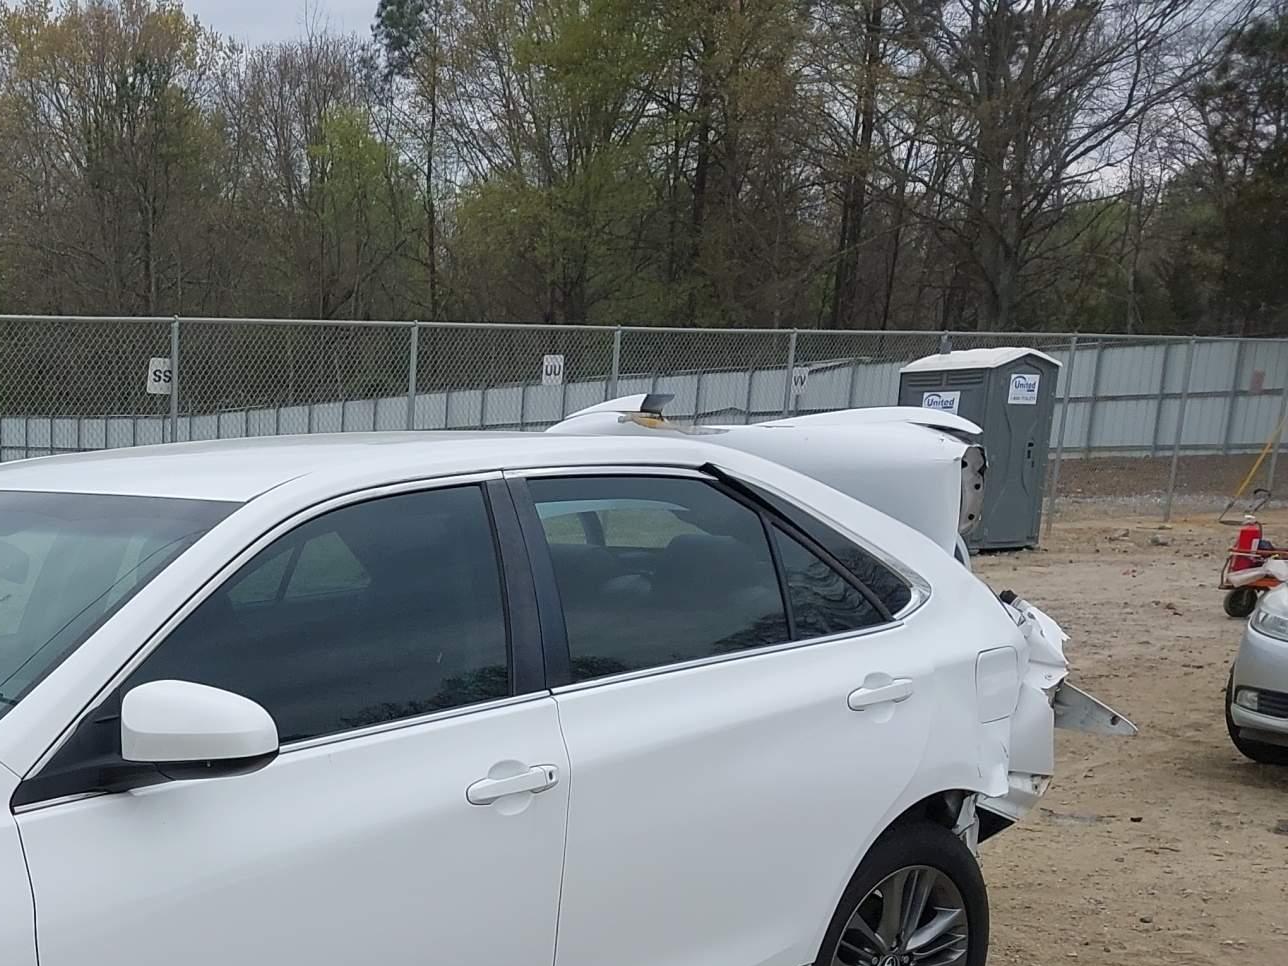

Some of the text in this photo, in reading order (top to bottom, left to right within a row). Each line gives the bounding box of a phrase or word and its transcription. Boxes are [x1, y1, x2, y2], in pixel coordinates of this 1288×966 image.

[545, 364, 561, 376] UU
[153, 369, 172, 383] SS
[1015, 380, 1037, 389] United
[927, 397, 955, 407] United
